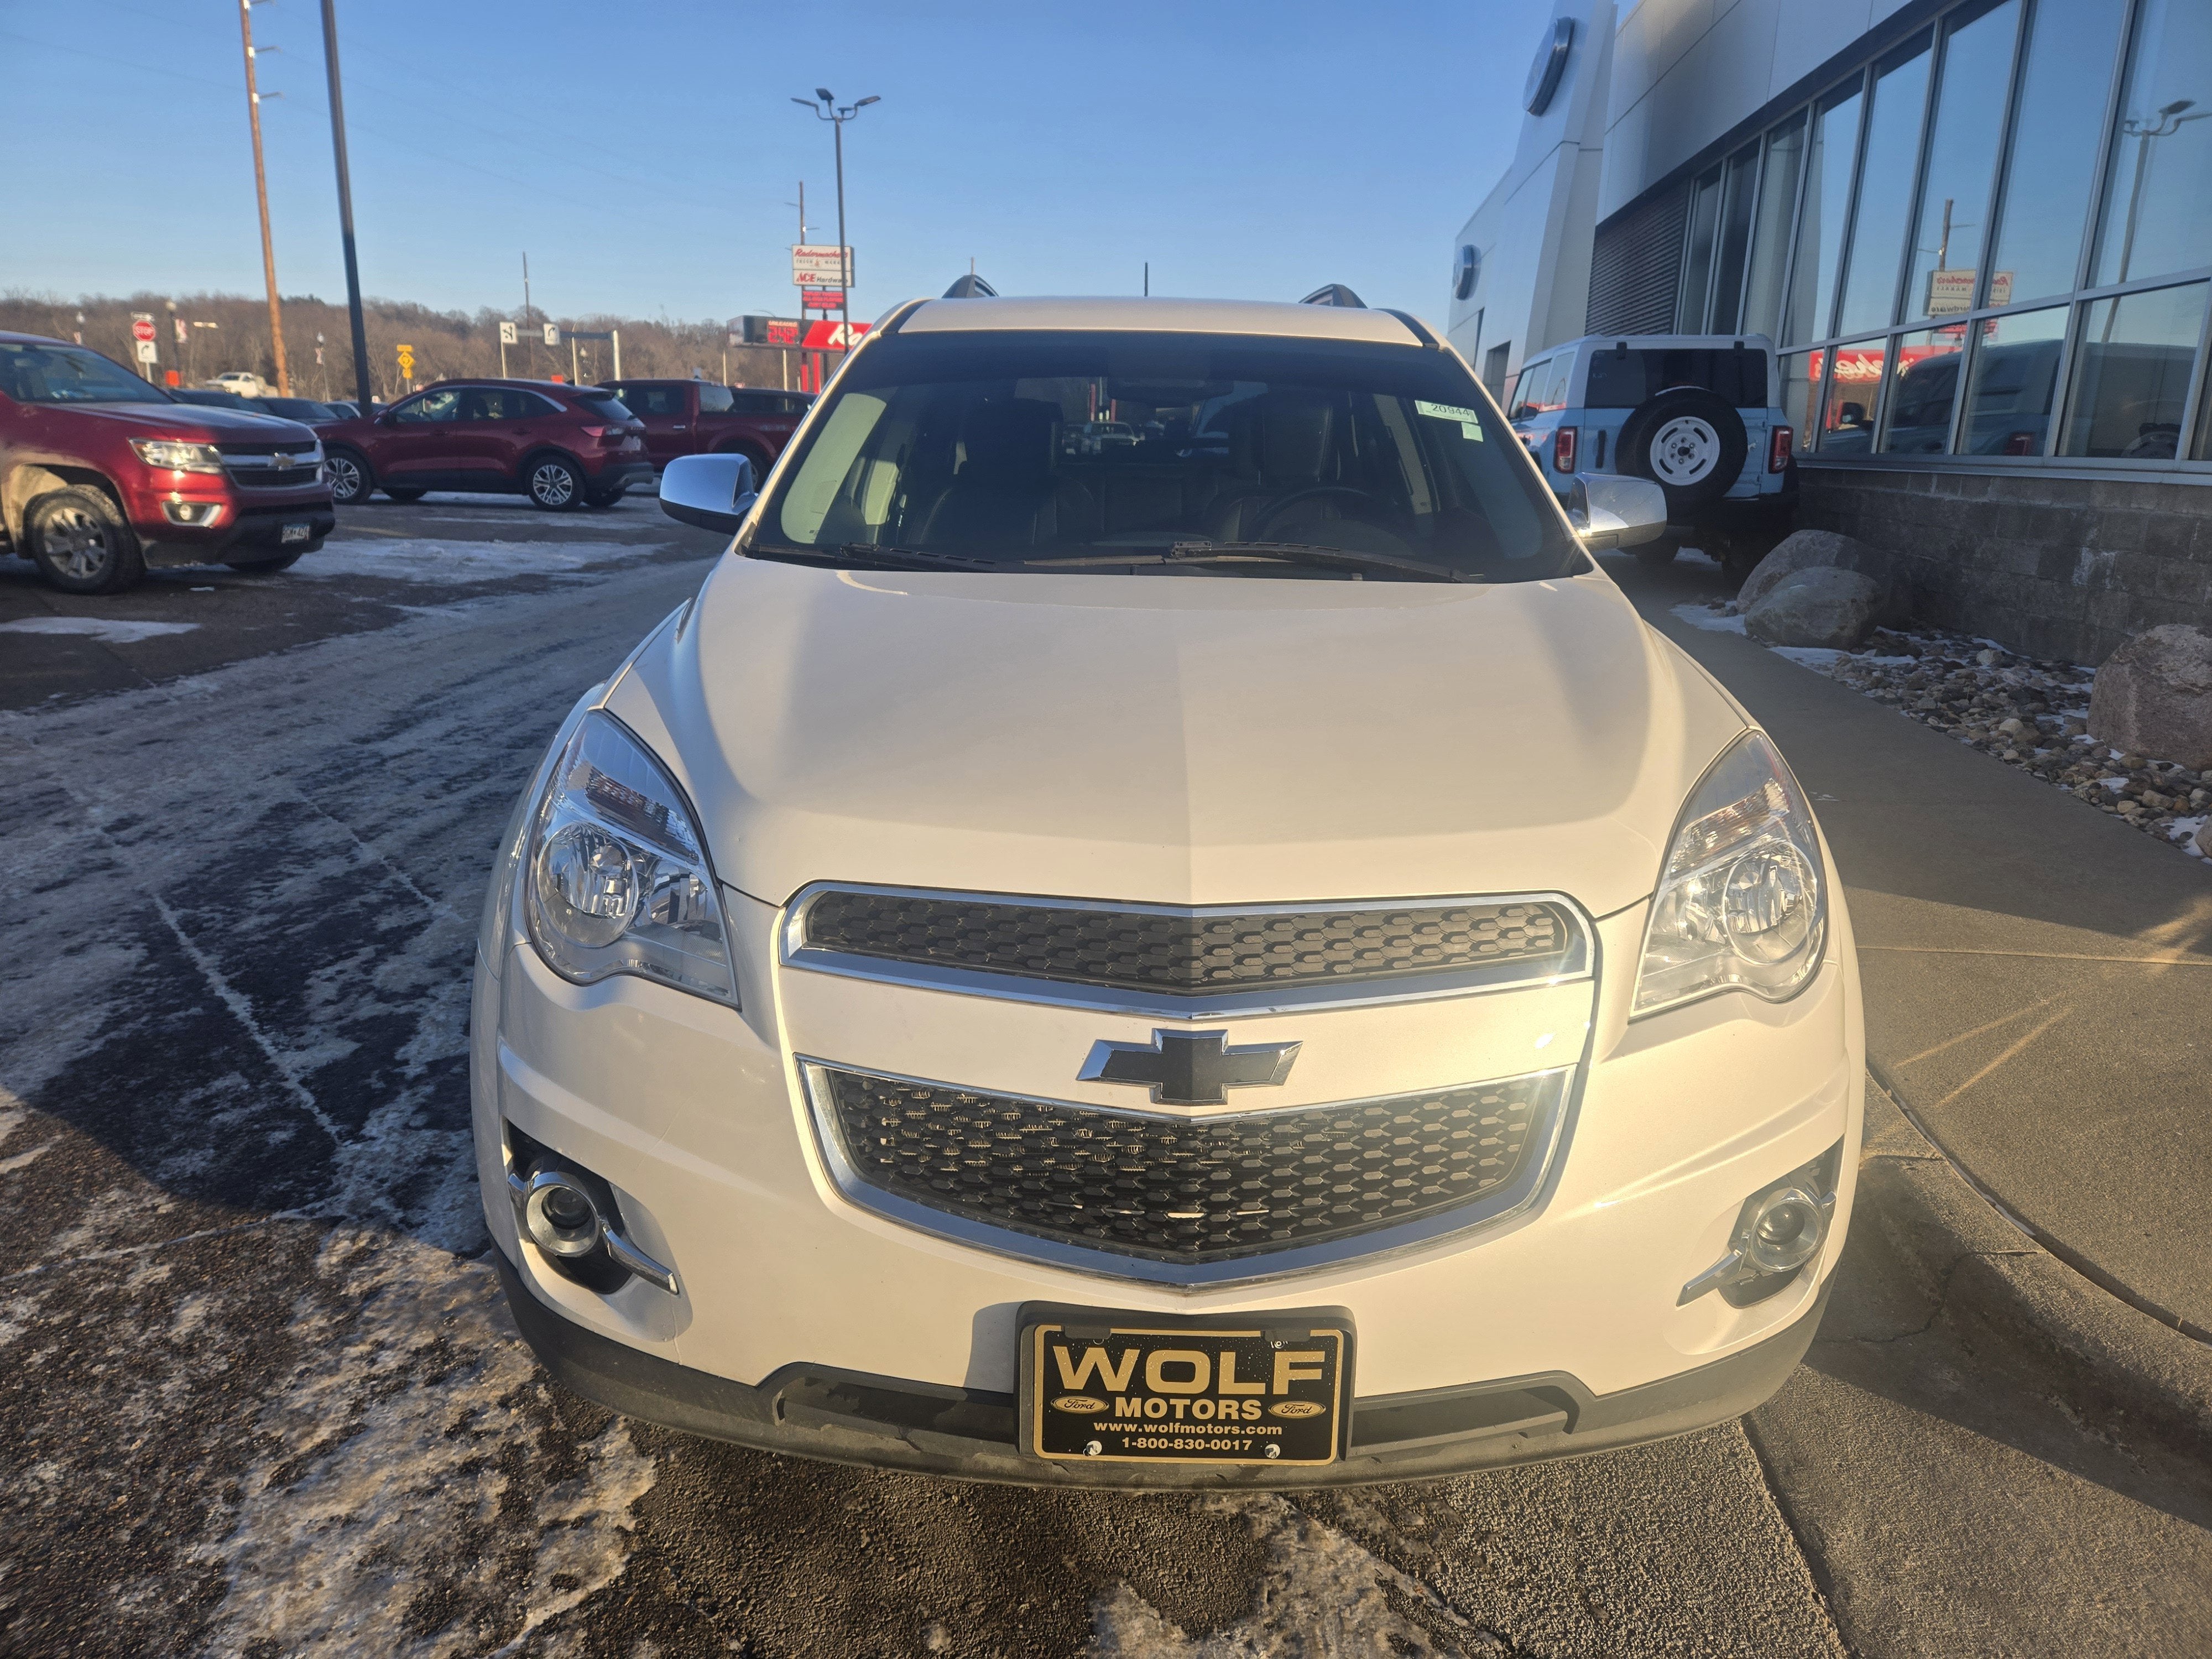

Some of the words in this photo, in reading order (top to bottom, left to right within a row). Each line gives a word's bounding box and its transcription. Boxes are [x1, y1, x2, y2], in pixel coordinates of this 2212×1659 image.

[796, 272, 815, 282] ACE
[133, 325, 155, 335] STOP
[1431, 404, 1470, 416] 20944
[1053, 1346, 1325, 1395] WOLF
[1065, 1399, 1096, 1410] Ford
[1115, 1397, 1262, 1420] MOTORS
[1281, 1404, 1312, 1414] Ford
[1093, 1422, 1282, 1435] www.wolfmotors.com
[1122, 1437, 1253, 1451] 1-800-830-0017
